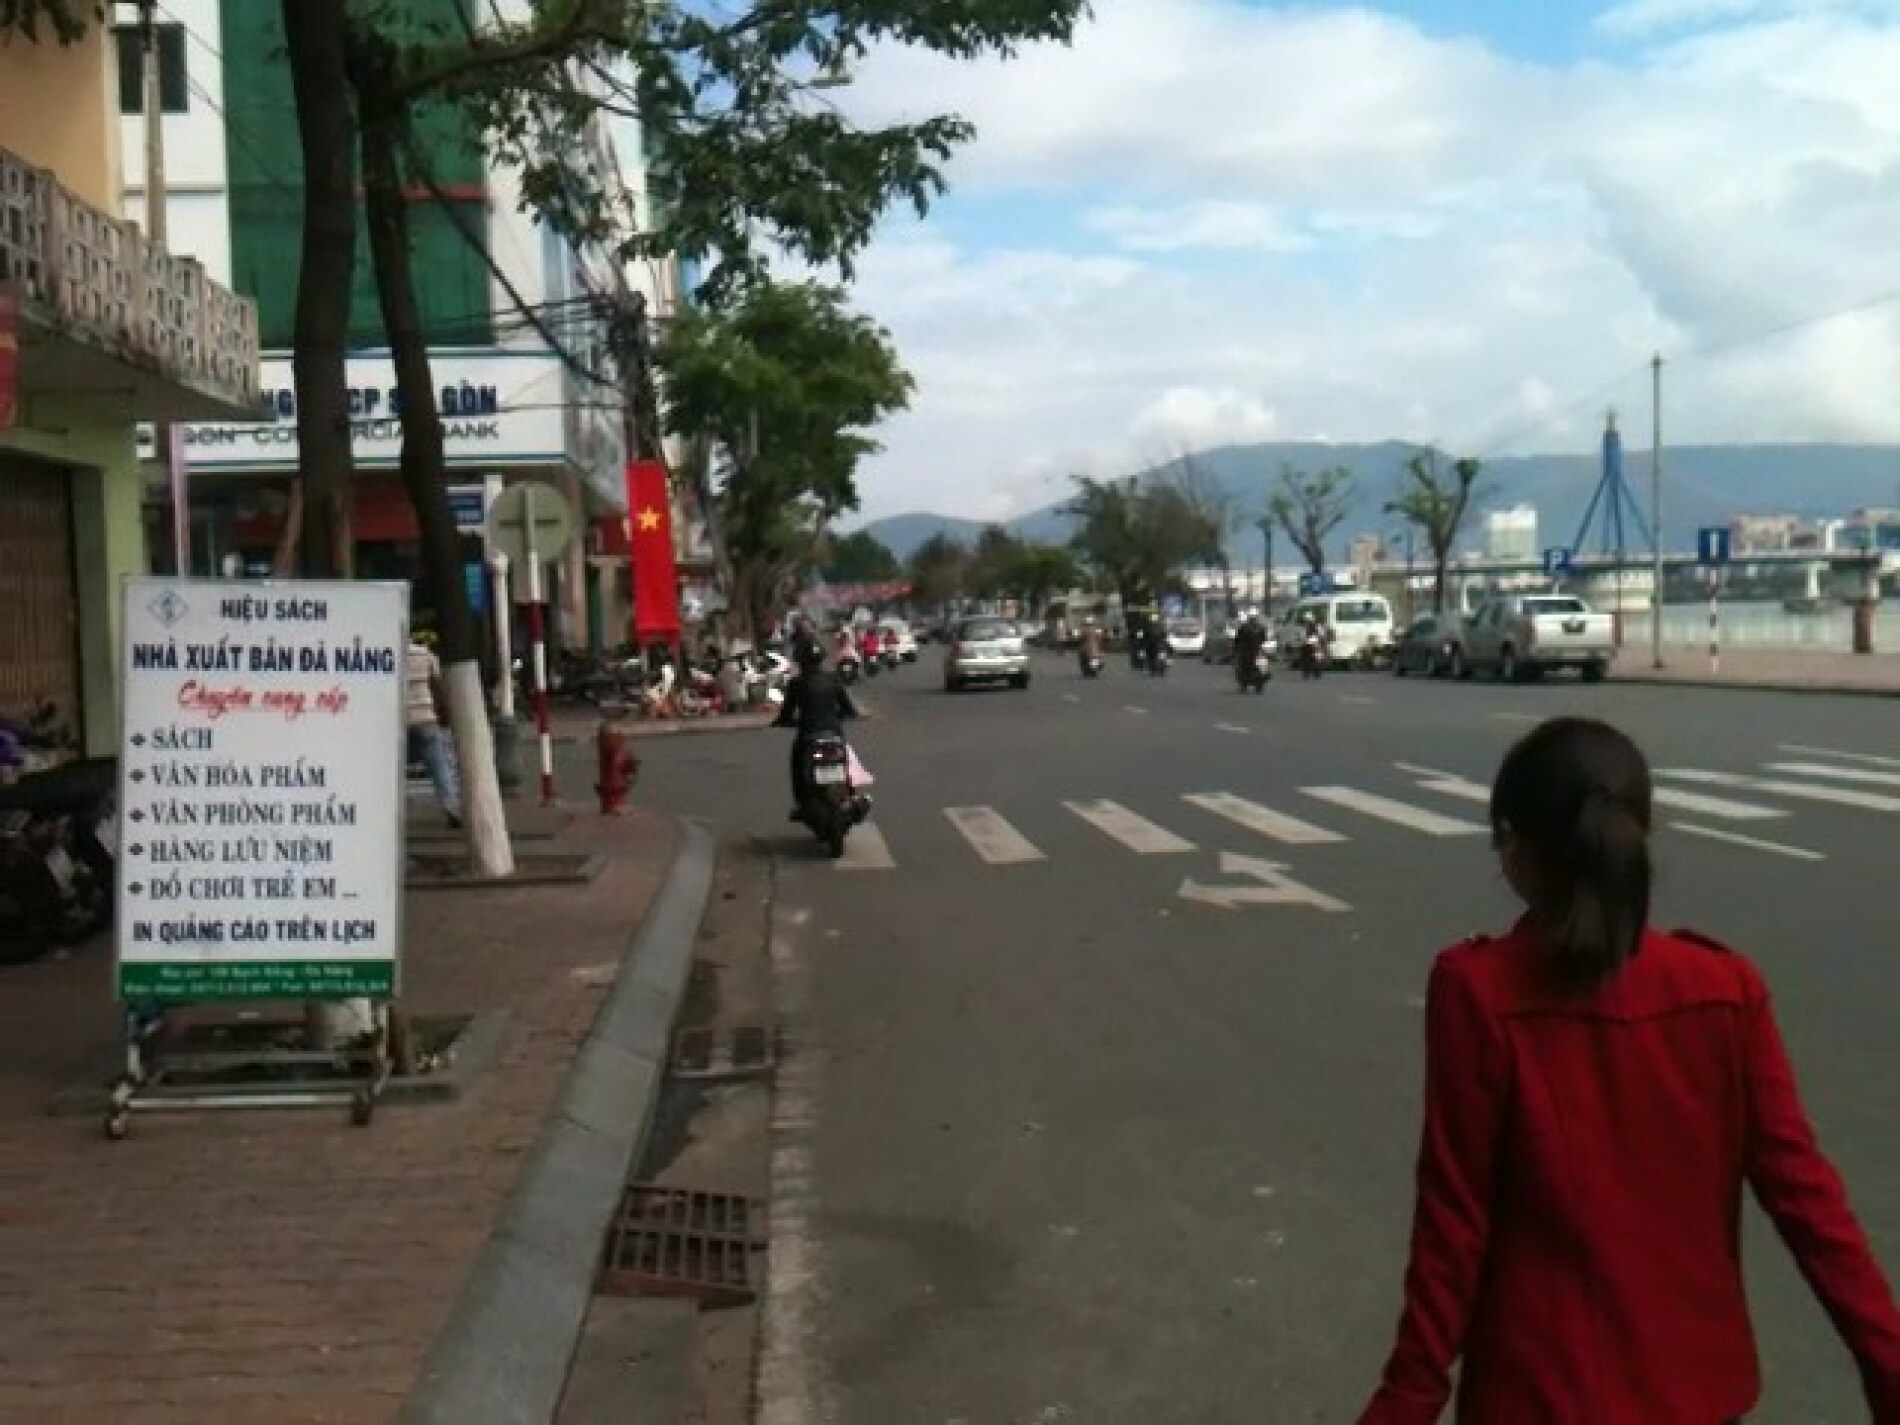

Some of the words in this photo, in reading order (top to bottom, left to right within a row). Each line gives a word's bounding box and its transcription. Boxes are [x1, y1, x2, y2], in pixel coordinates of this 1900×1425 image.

[442, 380, 497, 417] GÒN
[220, 593, 268, 624] HIỆU
[275, 595, 328, 622] SÁCH
[132, 634, 179, 669] NHÀ
[250, 635, 295, 672] BẢN
[151, 724, 214, 750] SÁCH
[204, 798, 284, 826] PHÒNG
[276, 834, 334, 865] NIỆM
[133, 919, 152, 942] IN
[159, 912, 225, 944] QUẢNG
[275, 914, 328, 942] TRÊN
[332, 920, 377, 944] LỊCH
